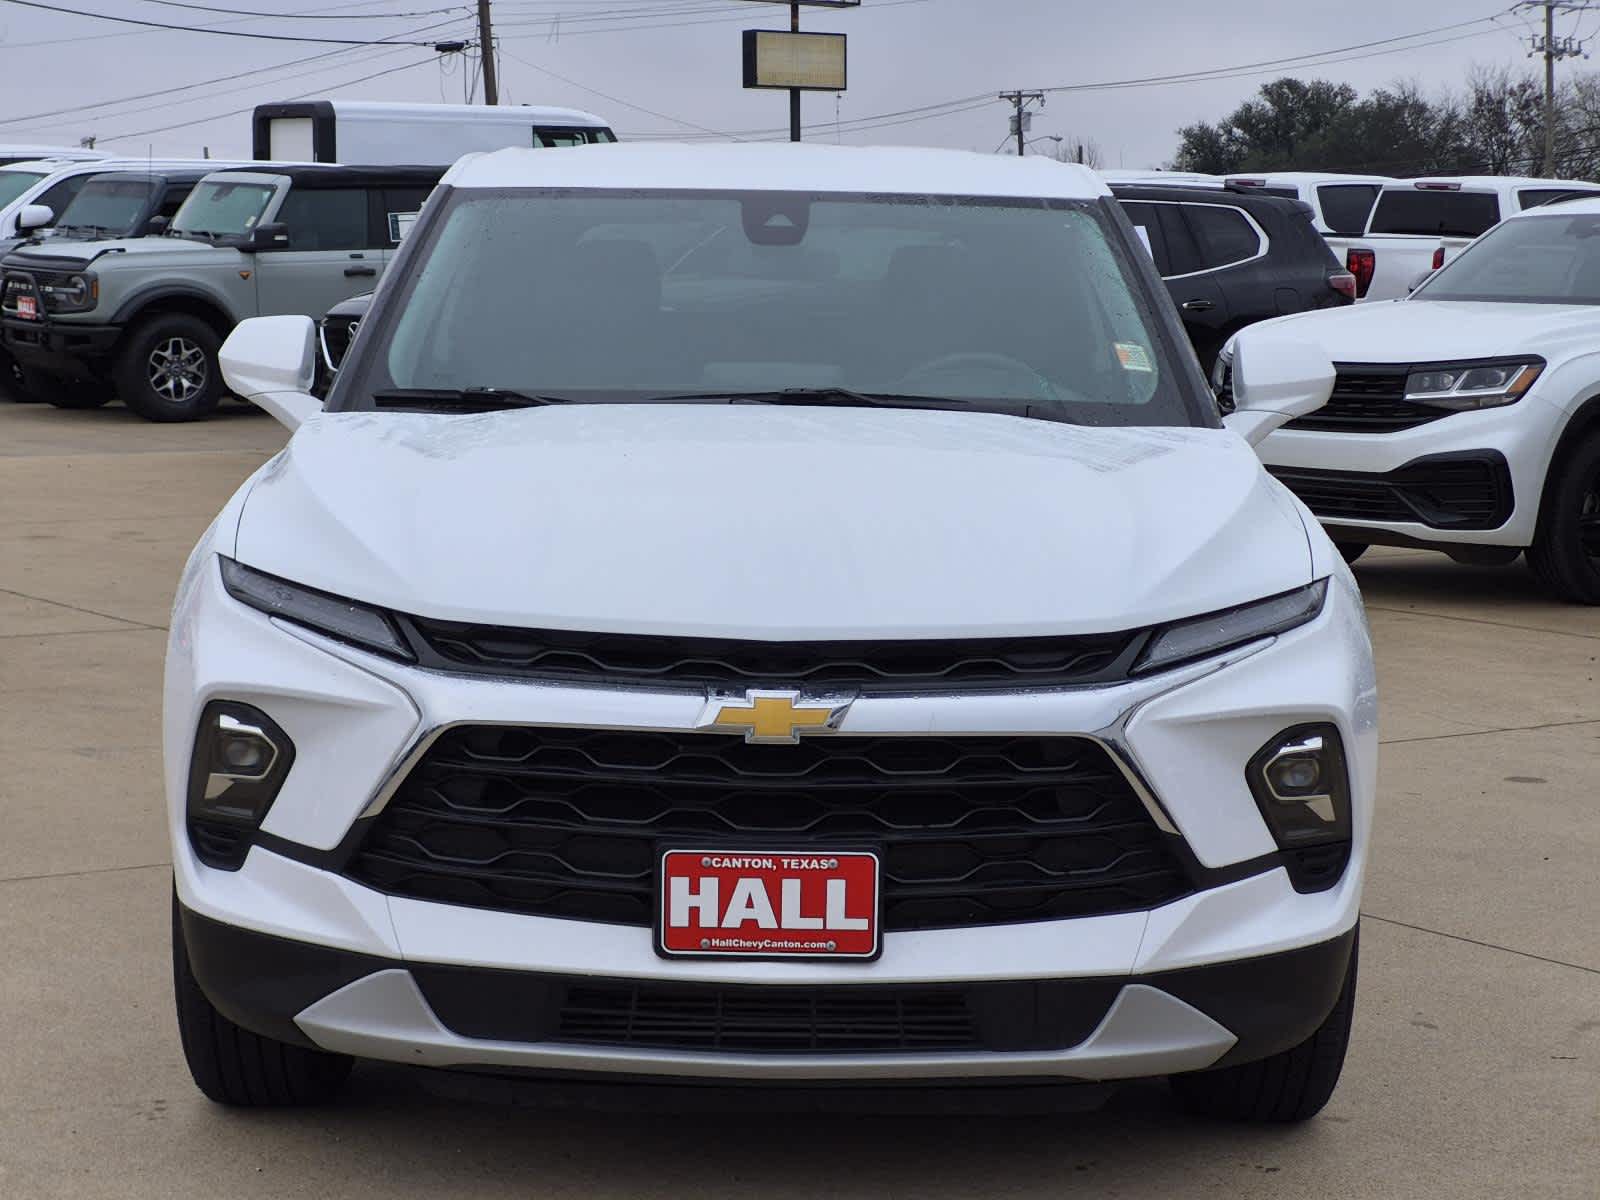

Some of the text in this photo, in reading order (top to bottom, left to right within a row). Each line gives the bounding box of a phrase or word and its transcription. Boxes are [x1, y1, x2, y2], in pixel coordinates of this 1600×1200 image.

[711, 857, 829, 870] CANTON, TEXAS
[669, 876, 869, 931] HALL
[711, 937, 827, 950] HallChevyCanton.com
